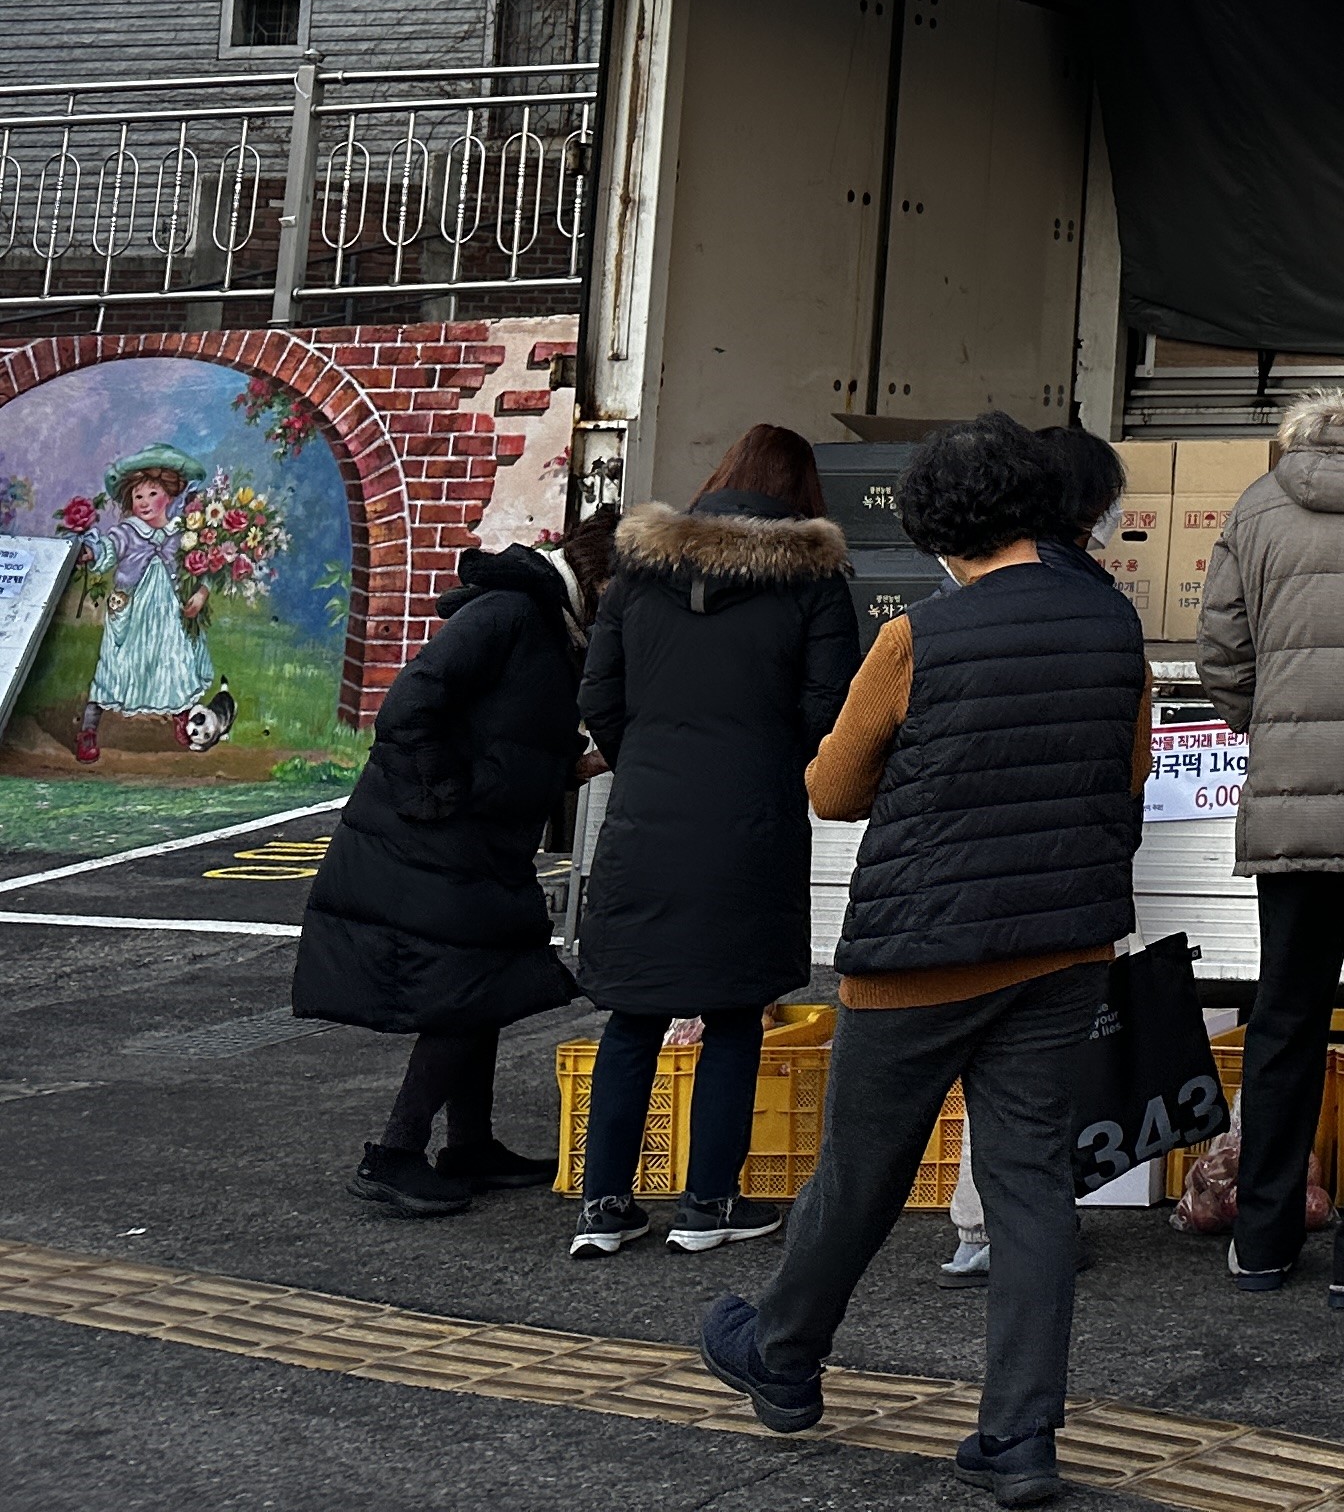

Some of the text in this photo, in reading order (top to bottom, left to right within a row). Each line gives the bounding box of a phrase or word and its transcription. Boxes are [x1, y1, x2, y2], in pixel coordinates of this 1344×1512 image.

[1178, 733, 1212, 749] 직거래
[1210, 751, 1249, 776] 1kg
[1077, 1074, 1225, 1189] 343
